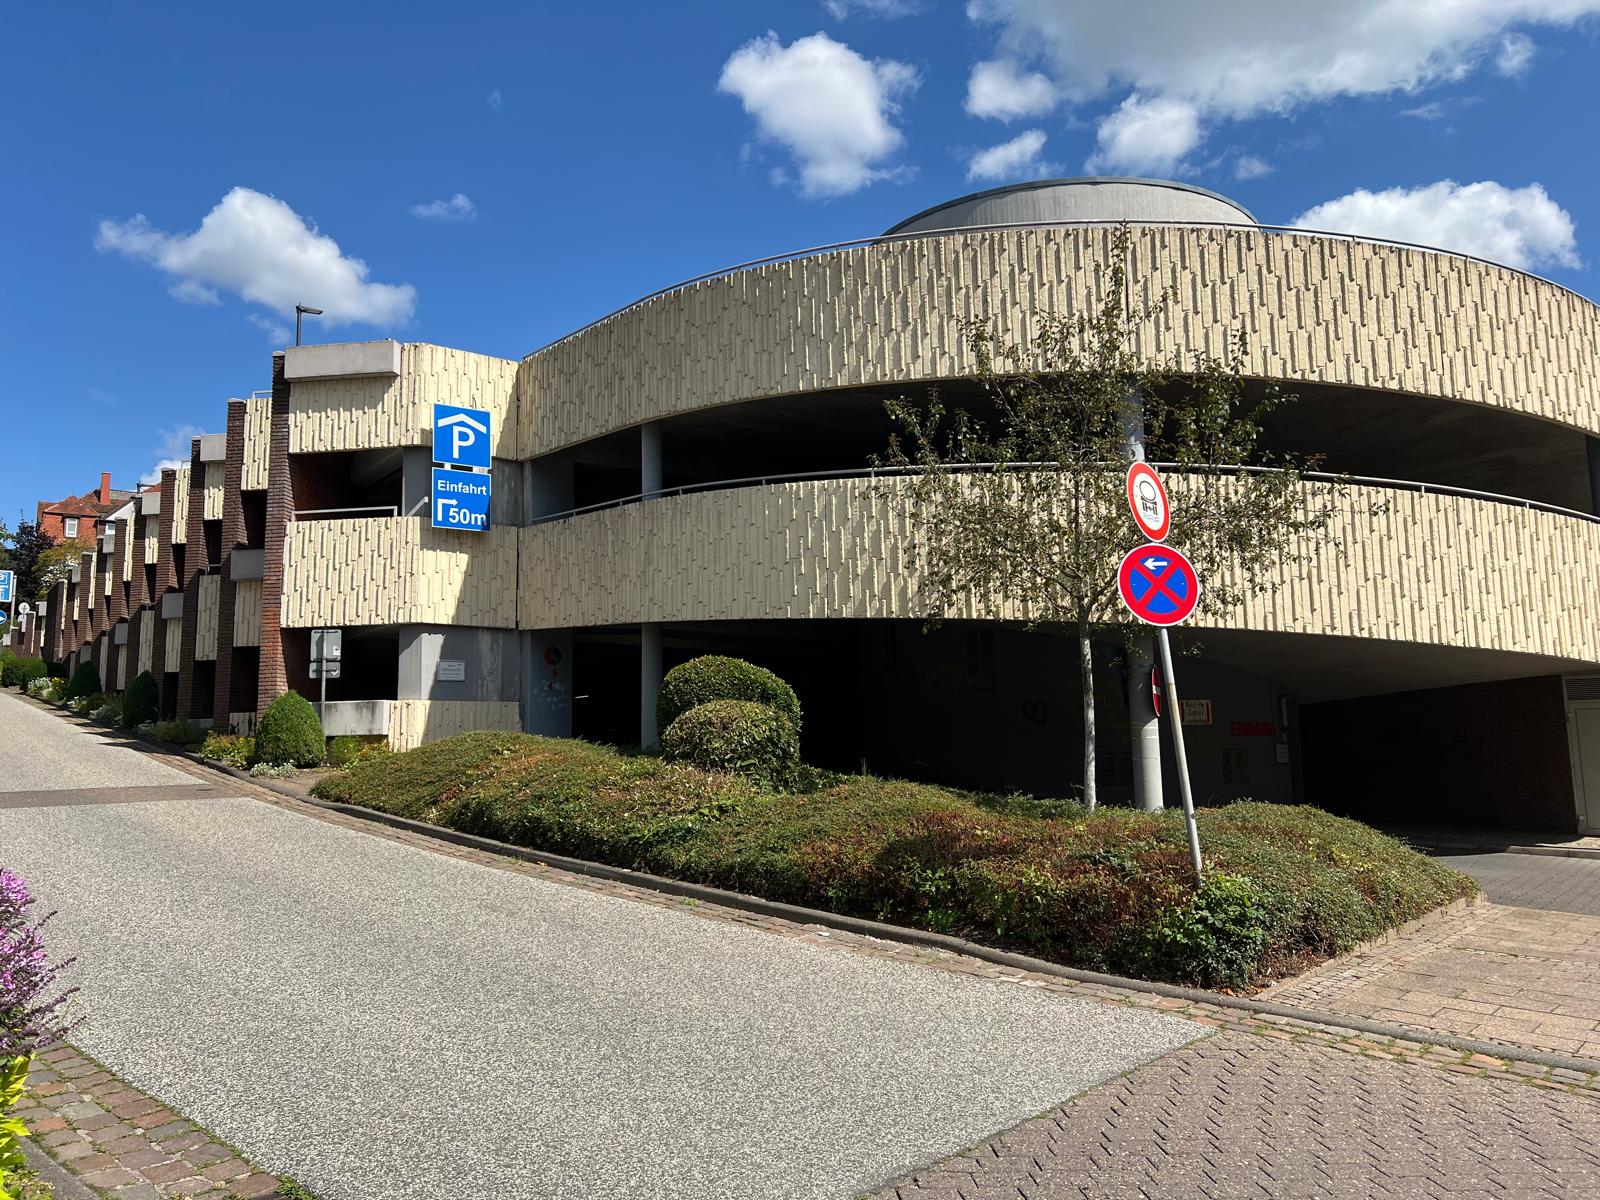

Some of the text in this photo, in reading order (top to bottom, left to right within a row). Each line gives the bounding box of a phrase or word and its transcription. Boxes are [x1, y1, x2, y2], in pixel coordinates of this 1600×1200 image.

[452, 425, 476, 459] P
[437, 479, 487, 496] Einfahrt
[448, 507, 488, 526] 50m
